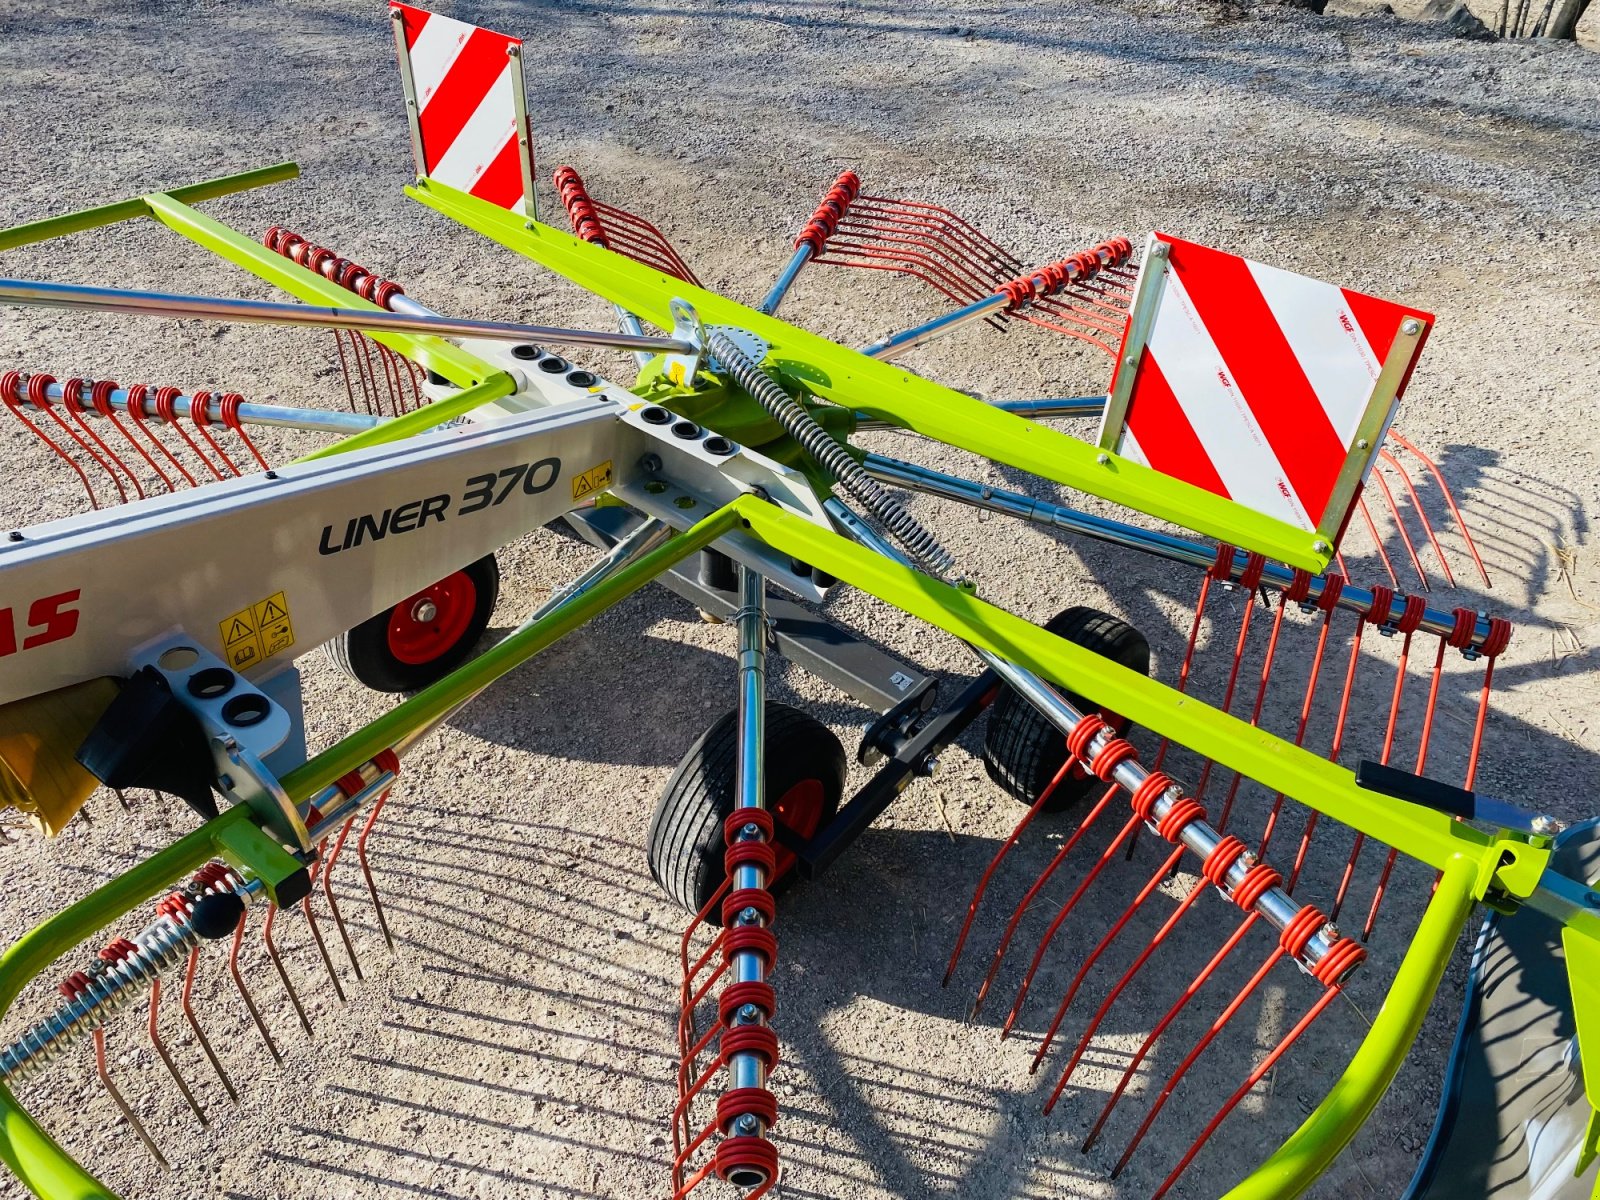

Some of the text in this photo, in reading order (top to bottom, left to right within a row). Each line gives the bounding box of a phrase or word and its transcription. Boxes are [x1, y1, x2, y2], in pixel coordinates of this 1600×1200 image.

[1339, 314, 1355, 333] WGF
[1218, 371, 1232, 388] WGF
[1277, 482, 1292, 498] WGF
[319, 457, 562, 556] LINER 370
